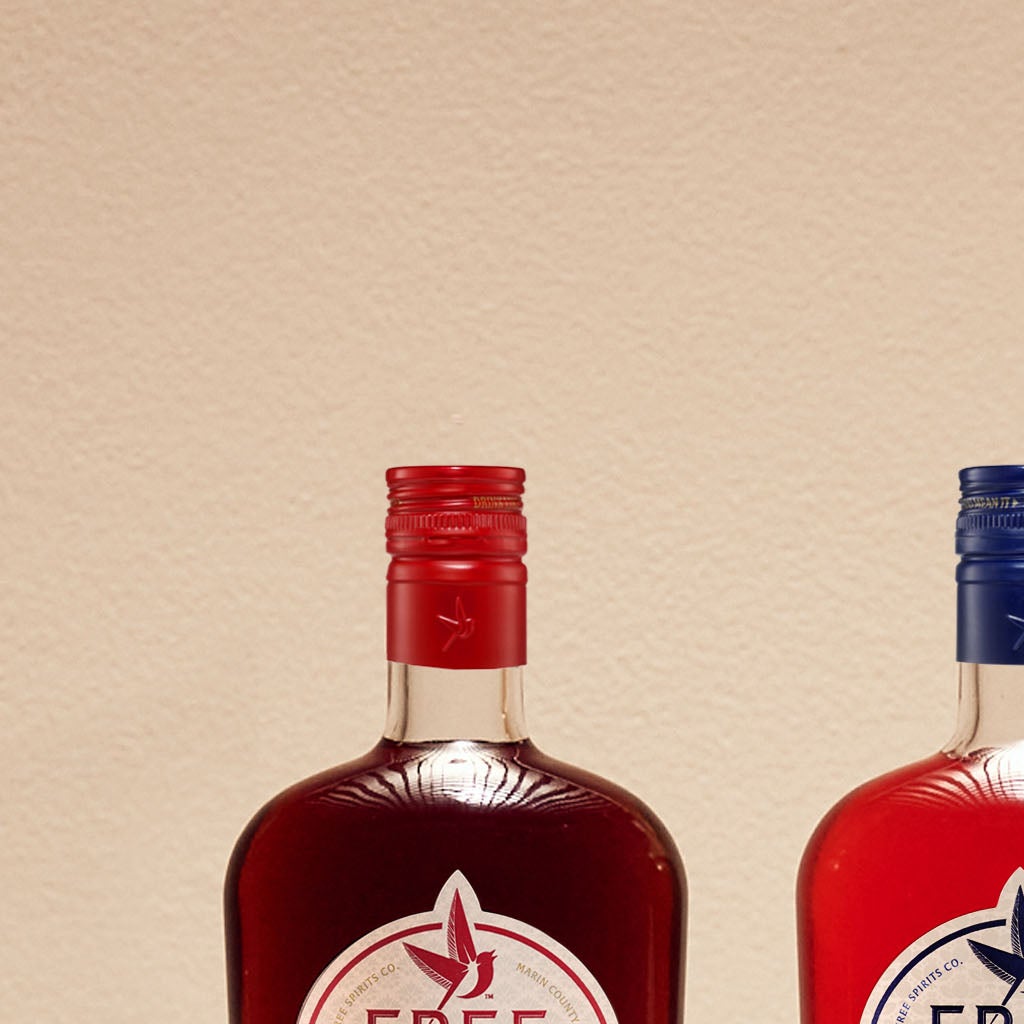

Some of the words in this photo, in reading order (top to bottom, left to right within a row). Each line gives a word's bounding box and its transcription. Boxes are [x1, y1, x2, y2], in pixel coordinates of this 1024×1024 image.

[344, 973, 379, 1007] SPIRITS
[380, 963, 400, 977] CO.
[515, 963, 549, 987] MARIN
[908, 968, 942, 1001] SPIRITS
[944, 958, 963, 972] CO.
